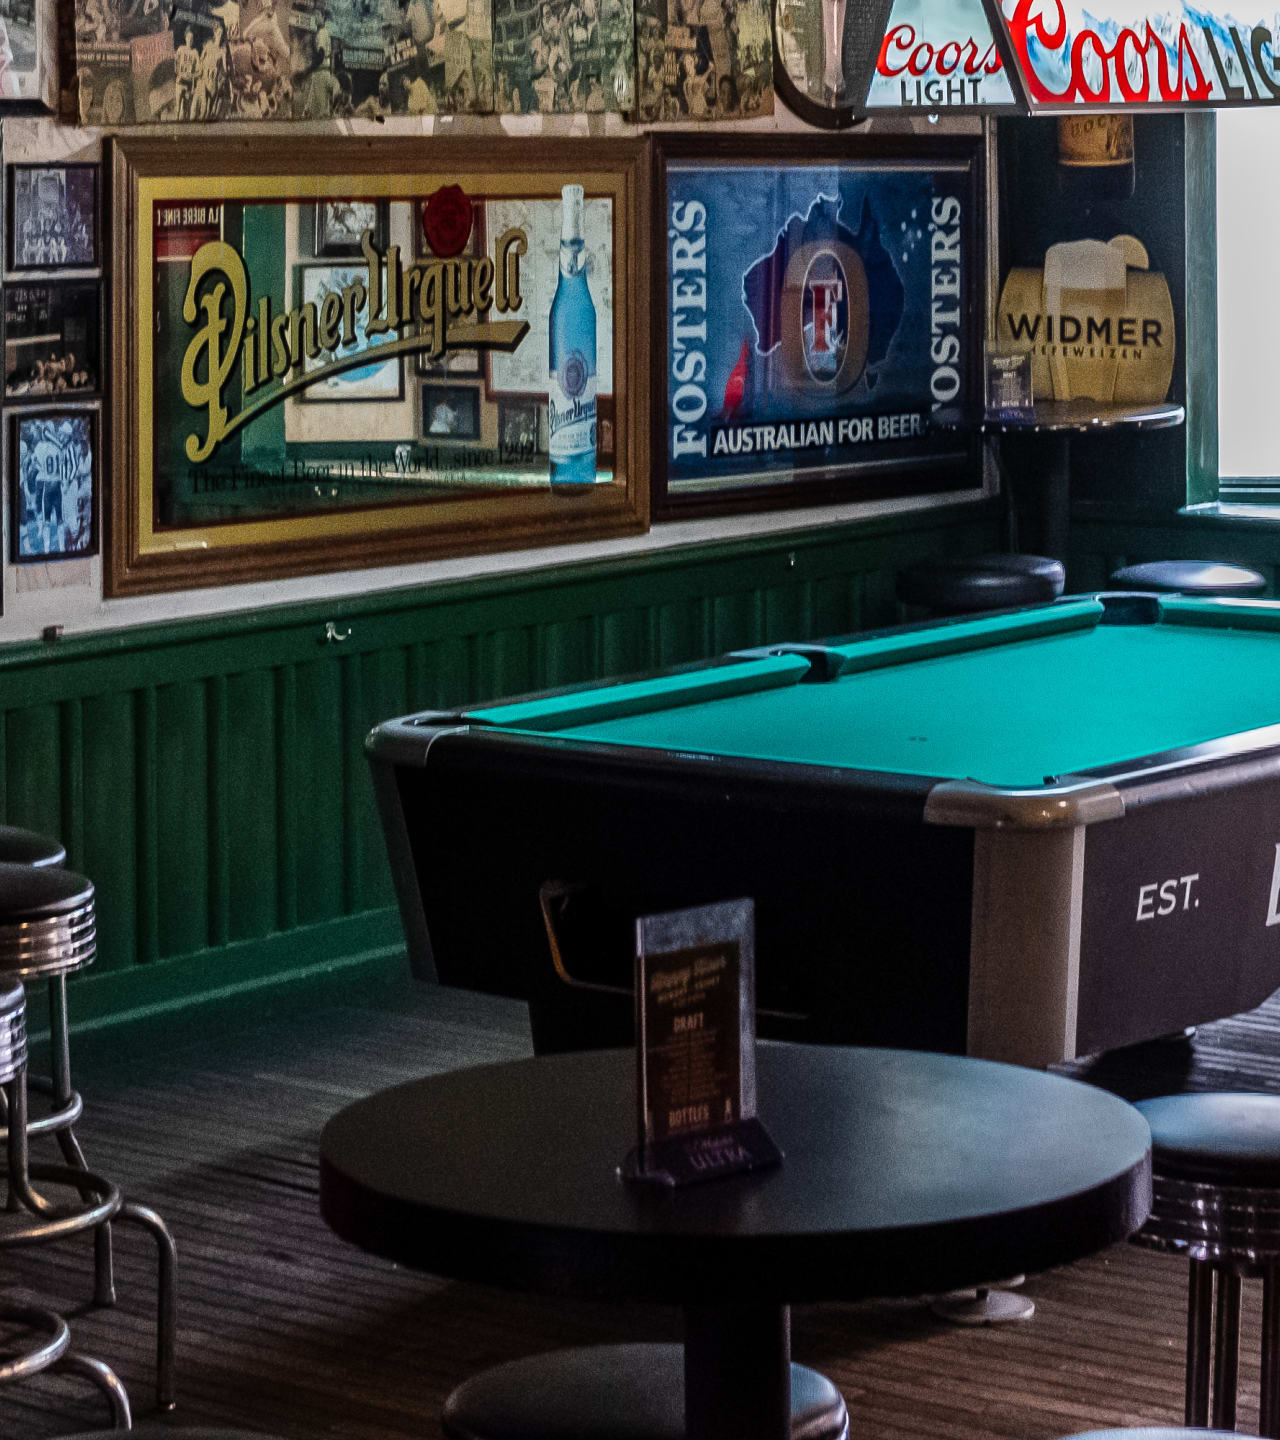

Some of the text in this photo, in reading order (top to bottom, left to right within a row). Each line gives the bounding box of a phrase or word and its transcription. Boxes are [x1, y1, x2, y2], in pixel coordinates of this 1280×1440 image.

[875, 23, 1003, 77] Coors
[899, 78, 980, 106] LIGHT
[180, 227, 528, 464] Pilsner Urquell
[672, 198, 708, 459] FOSTER'S
[1006, 312, 1163, 348] WIDMER
[712, 417, 834, 457] AUSTRALIAN
[838, 415, 874, 443] FOR
[188, 467, 224, 494] The
[229, 462, 287, 489] Finest
[293, 459, 334, 483] Beer
[337, 459, 355, 479] in
[356, 453, 389, 478] the
[1136, 873, 1200, 922] EST.
[672, 1011, 705, 1034] DRAFT
